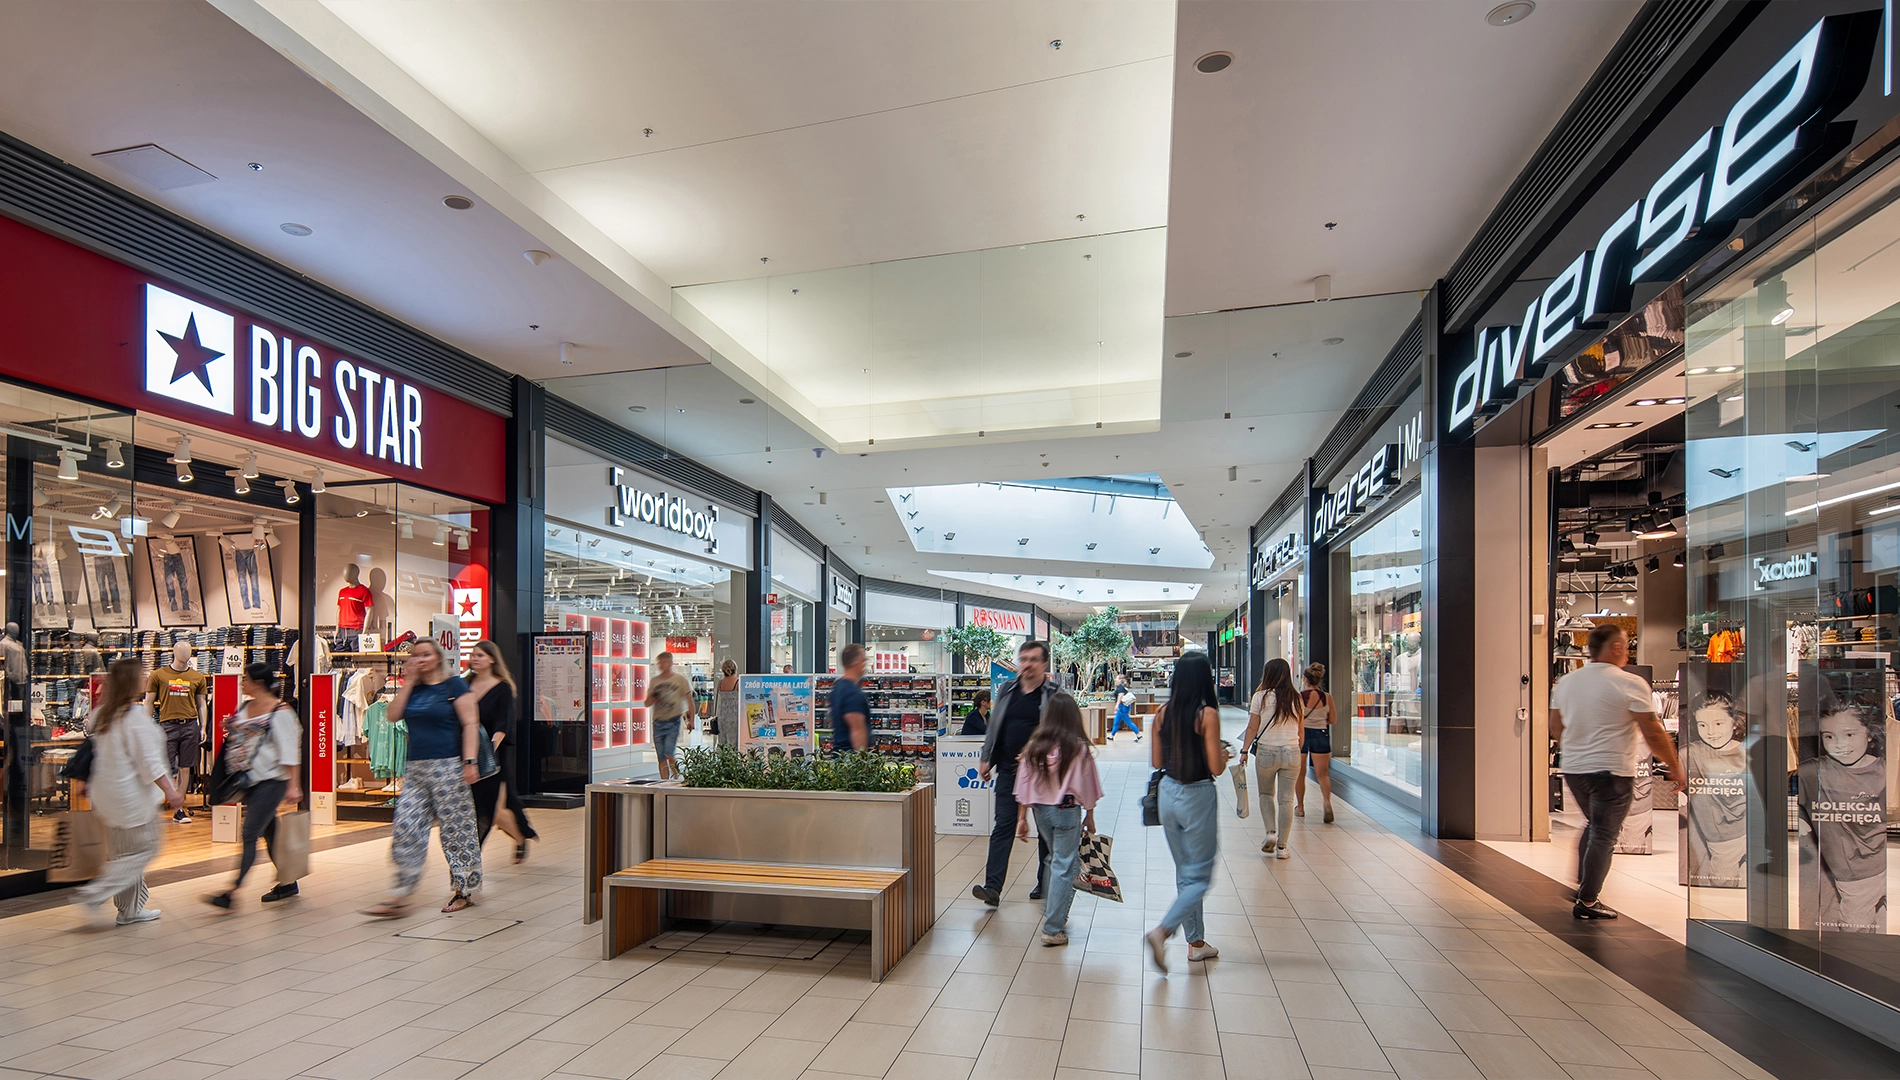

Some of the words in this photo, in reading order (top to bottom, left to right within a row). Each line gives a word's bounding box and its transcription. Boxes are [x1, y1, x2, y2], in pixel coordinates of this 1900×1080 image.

[1449, 15, 1826, 433] diverse
[251, 323, 322, 438] BIG
[335, 359, 423, 470] STAR
[1313, 444, 1387, 543] diverse
[618, 482, 715, 542] worldbox
[973, 608, 1026, 631] ROSSMANN
[612, 633, 626, 644] SALE
[632, 634, 645, 645] SALE
[745, 680, 761, 689] ZRÓB
[783, 681, 792, 689] NA
[612, 722, 626, 733] SALE
[632, 721, 646, 732] SALE
[1689, 777, 1744, 786] KOLEKCJA
[1689, 786, 1744, 797] DZIECIĘCA
[1811, 801, 1882, 812] KOLEKCJA
[1811, 812, 1882, 825] DZIECIĘCA
